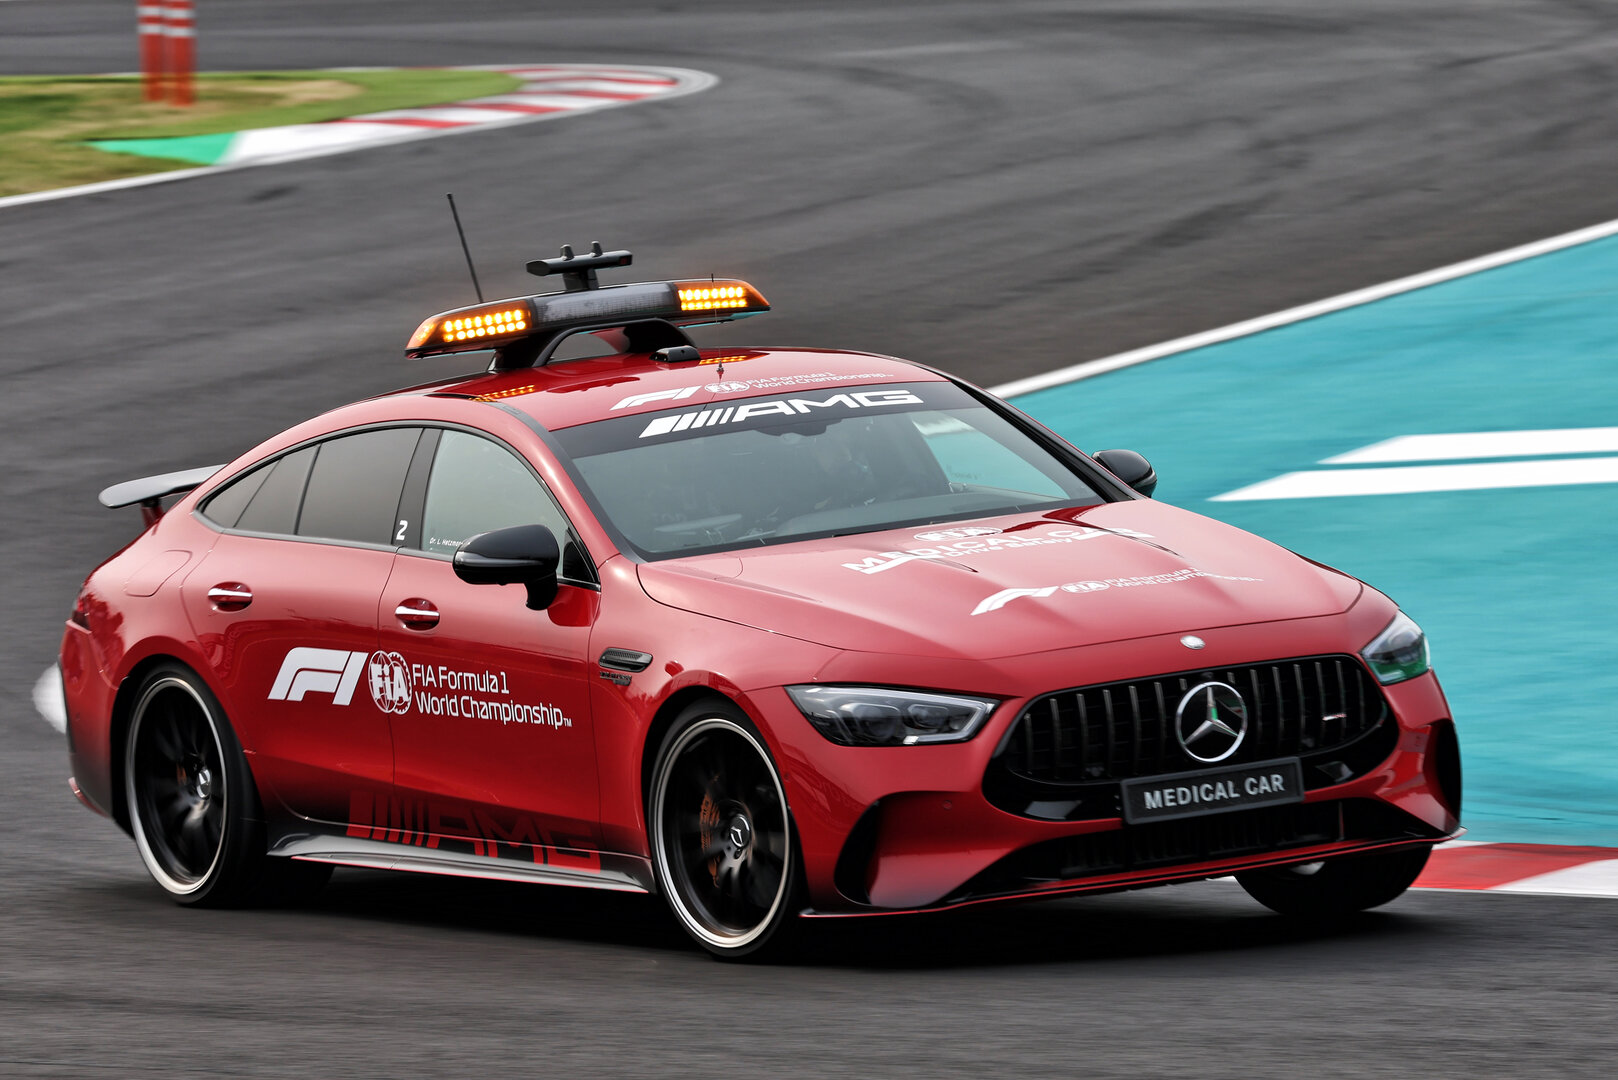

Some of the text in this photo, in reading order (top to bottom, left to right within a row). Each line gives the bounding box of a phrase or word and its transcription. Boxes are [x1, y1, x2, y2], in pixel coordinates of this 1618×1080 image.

[753, 381, 796, 389] World
[772, 373, 825, 382] Formula
[708, 382, 745, 393] FIA
[395, 520, 408, 540] 2
[942, 546, 1004, 557] Drive
[412, 663, 510, 694] FIA Formula 1
[414, 690, 459, 717] World
[460, 695, 563, 730] Championship
[1144, 773, 1286, 809] MEDICAL CAR
